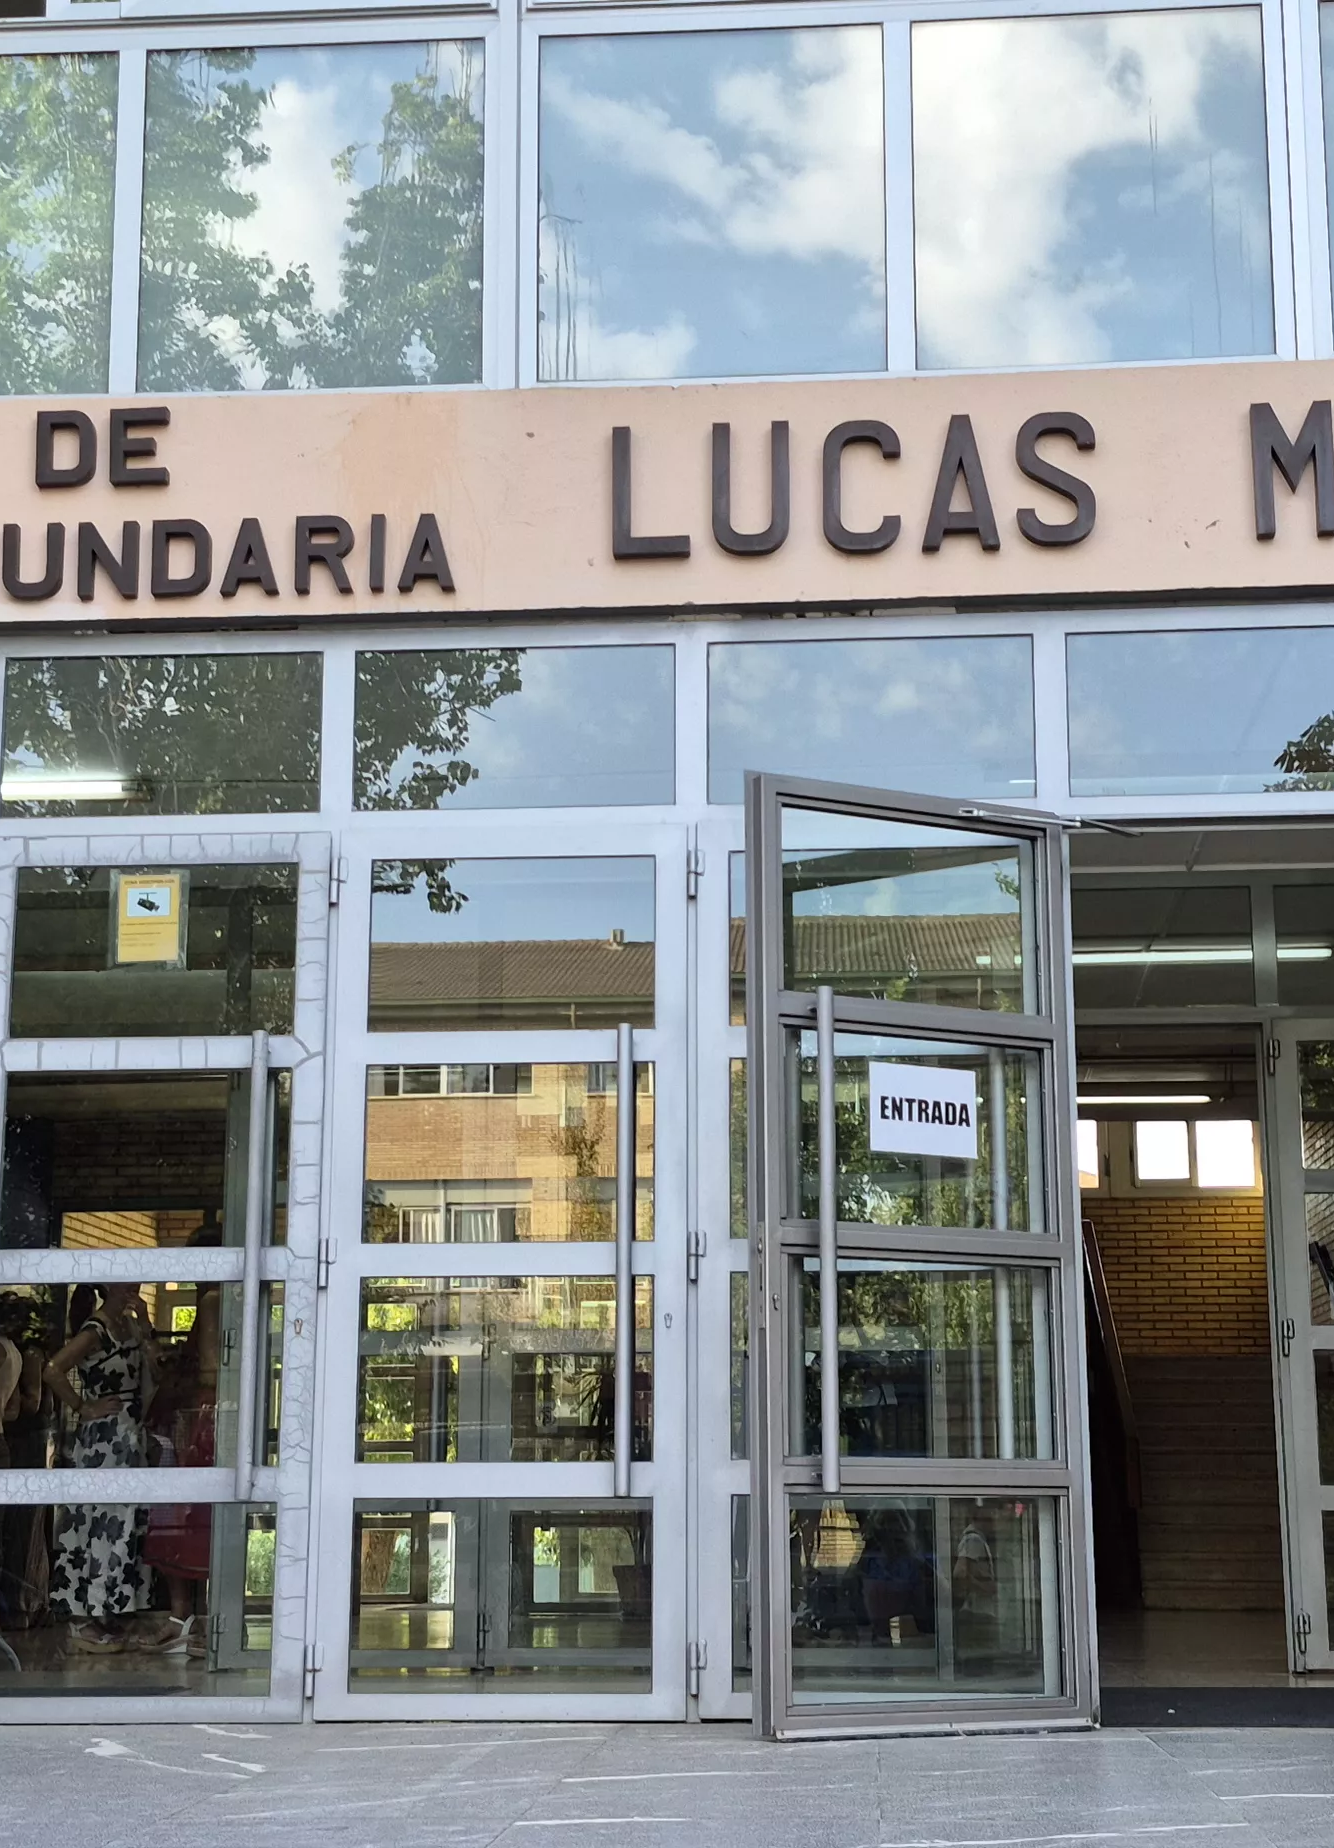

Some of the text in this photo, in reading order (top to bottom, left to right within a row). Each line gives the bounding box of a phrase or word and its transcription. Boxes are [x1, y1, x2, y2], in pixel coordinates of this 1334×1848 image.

[35, 406, 171, 490] DE
[611, 411, 1097, 560] LUCAS
[880, 1095, 971, 1128] ENTRADA
